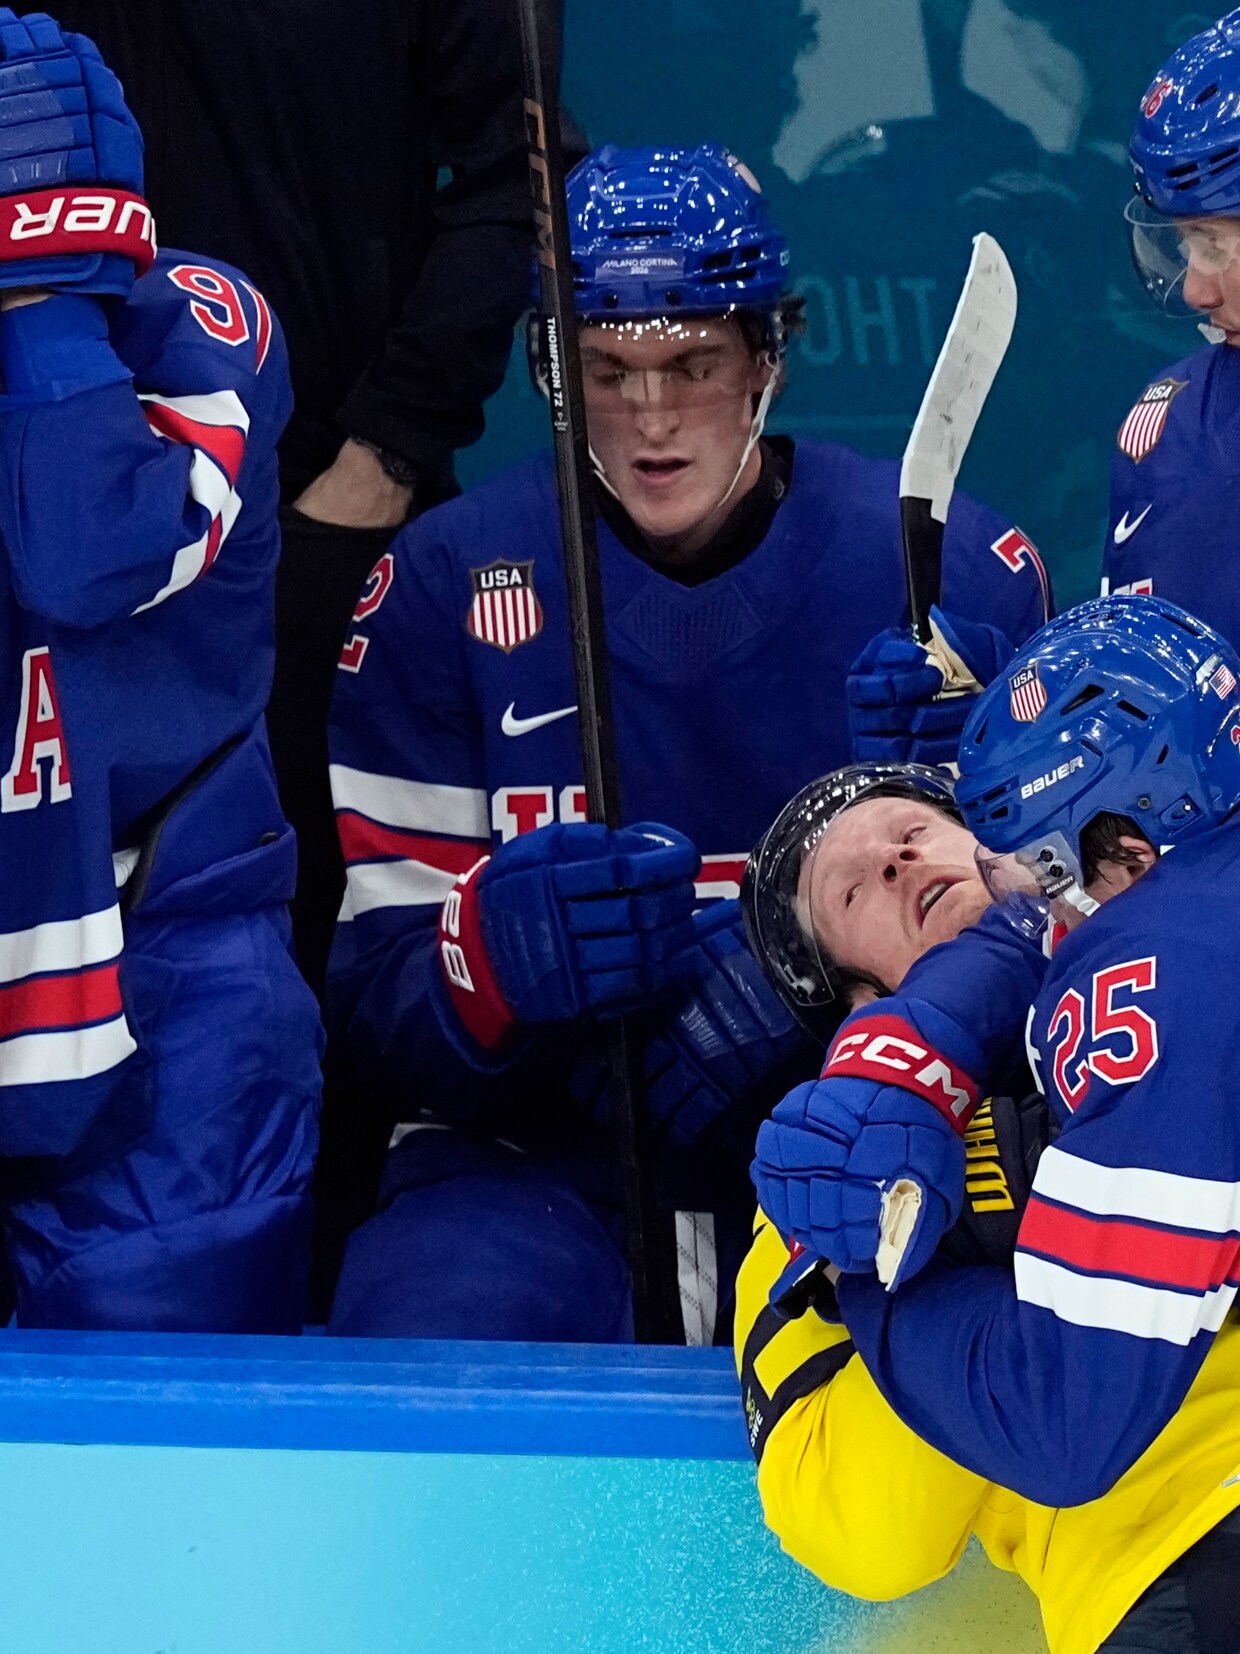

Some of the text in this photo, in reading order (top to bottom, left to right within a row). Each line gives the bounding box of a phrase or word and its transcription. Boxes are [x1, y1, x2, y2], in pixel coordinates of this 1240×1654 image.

[1140, 72, 1174, 119] 6
[602, 258, 678, 268] MILANO CORTINA
[630, 266, 649, 275] 2026
[547, 317, 562, 390] THOMPSON
[553, 391, 564, 408] 72
[1143, 384, 1173, 401] USA
[480, 569, 523, 589] USA
[1012, 671, 1035, 689] USA
[1021, 755, 1085, 800] BAUER
[1046, 875, 1074, 895] BAUER
[1047, 956, 1160, 1114] 25
[828, 1032, 971, 1119] CCM
[750, 1409, 764, 1448] SWE
